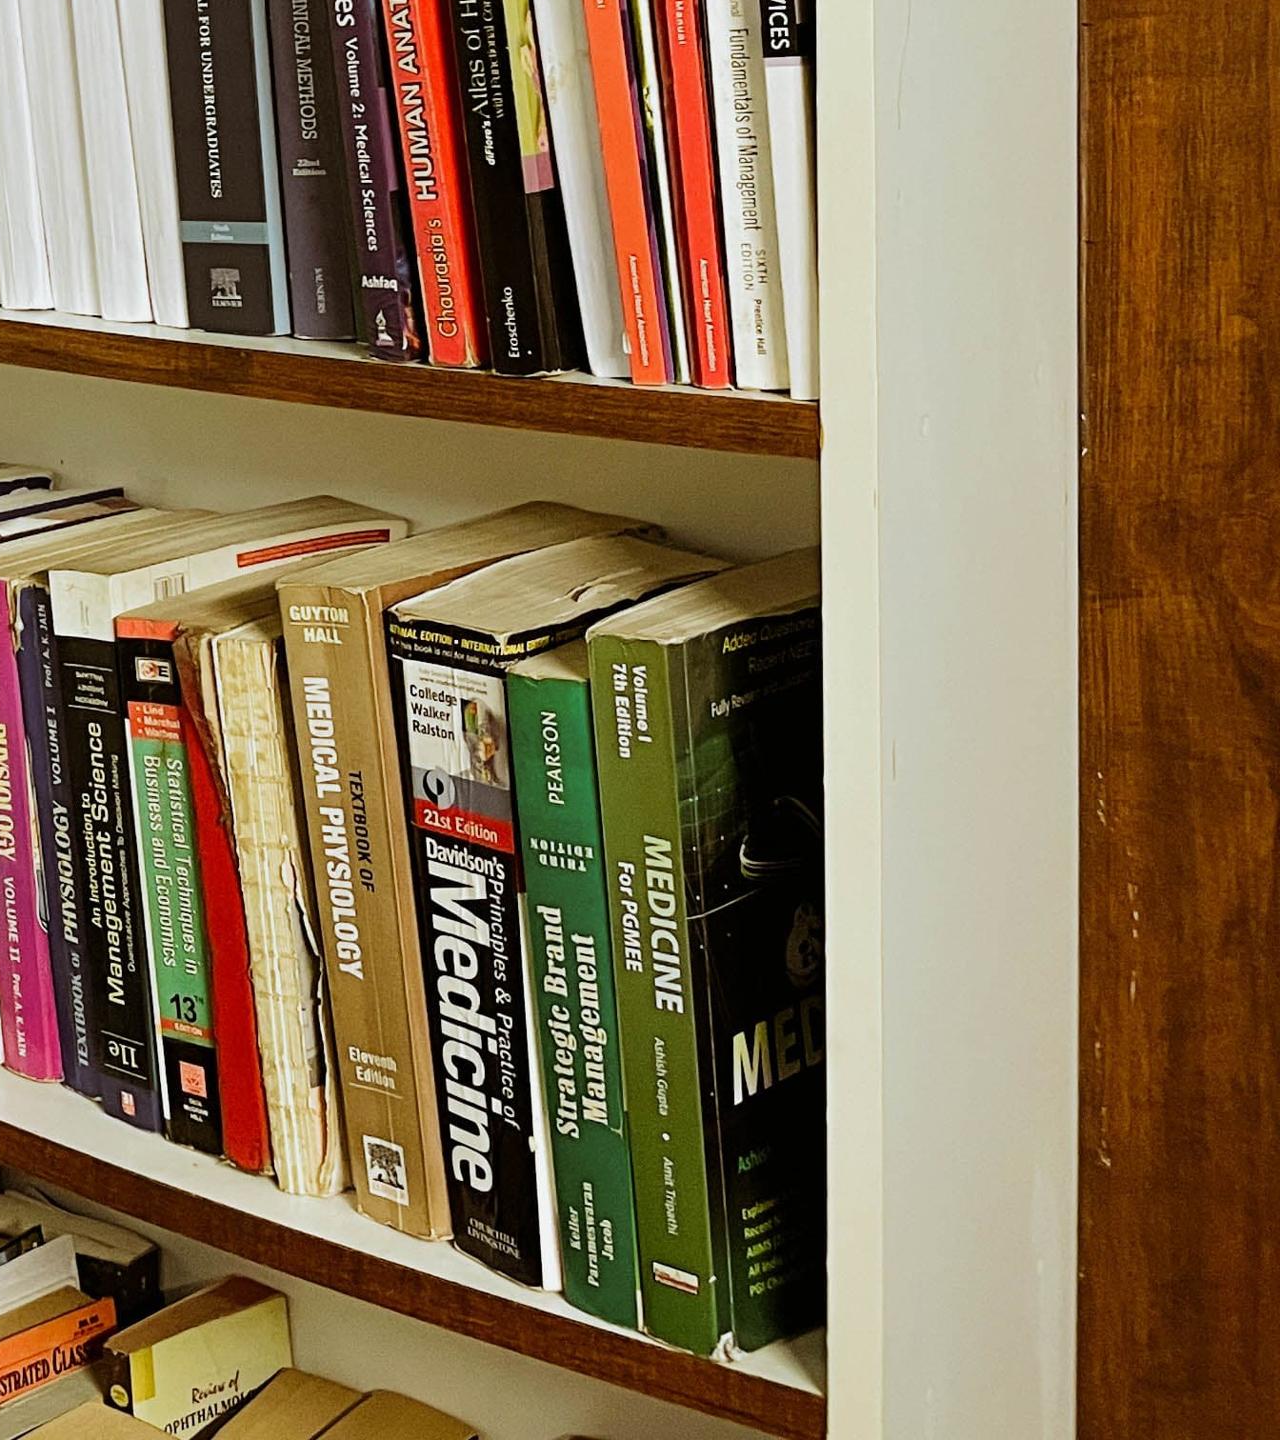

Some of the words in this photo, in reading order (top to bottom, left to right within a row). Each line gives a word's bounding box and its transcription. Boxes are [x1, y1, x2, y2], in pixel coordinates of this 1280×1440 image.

[197, 16, 212, 47] FOR
[345, 37, 360, 98] Volume
[200, 50, 223, 199] UNDERGRADUATES
[351, 103, 365, 119] 2:
[355, 124, 373, 185] Medical
[404, 84, 437, 202] HUMAN
[361, 188, 378, 251] Sciences
[362, 275, 398, 291] Ashfaq
[427, 218, 458, 337] Chaurasia's
[290, 606, 348, 623] GUYTON
[304, 628, 342, 645] HALL
[410, 685, 457, 706] Colledge
[612, 663, 627, 691] 7th
[303, 676, 342, 799] MEDICAL
[410, 704, 451, 722] Walker
[413, 720, 455, 742] Ralston
[615, 696, 631, 759] Edition
[90, 722, 109, 823] Science
[540, 711, 563, 804] PEARSON
[144, 756, 163, 831] Business
[348, 770, 372, 861] TEXTBOOK
[152, 835, 168, 873] and
[423, 809, 451, 830] 21st
[455, 816, 498, 843] Edition
[359, 866, 375, 893] OF
[425, 837, 505, 880] Davidson's
[97, 831, 125, 1005] Management
[156, 876, 176, 967] Economics
[320, 807, 363, 981] PHYSIOLOGY
[643, 834, 684, 1014] MEDICINE
[490, 878, 510, 982] Principles
[536, 905, 569, 998] Brand
[494, 987, 511, 1004] &
[427, 862, 497, 1193] Medicine
[497, 1012, 514, 1100] Practice
[571, 932, 608, 1125] Management
[547, 1004, 580, 1139] Strategic
[503, 1104, 520, 1131] of
[569, 1206, 581, 1250] Keller
[582, 1181, 600, 1287] Parameswaran
[600, 1219, 614, 1261] Jacob
[191, 1382, 224, 1404] Review
[228, 1370, 239, 1392] of
